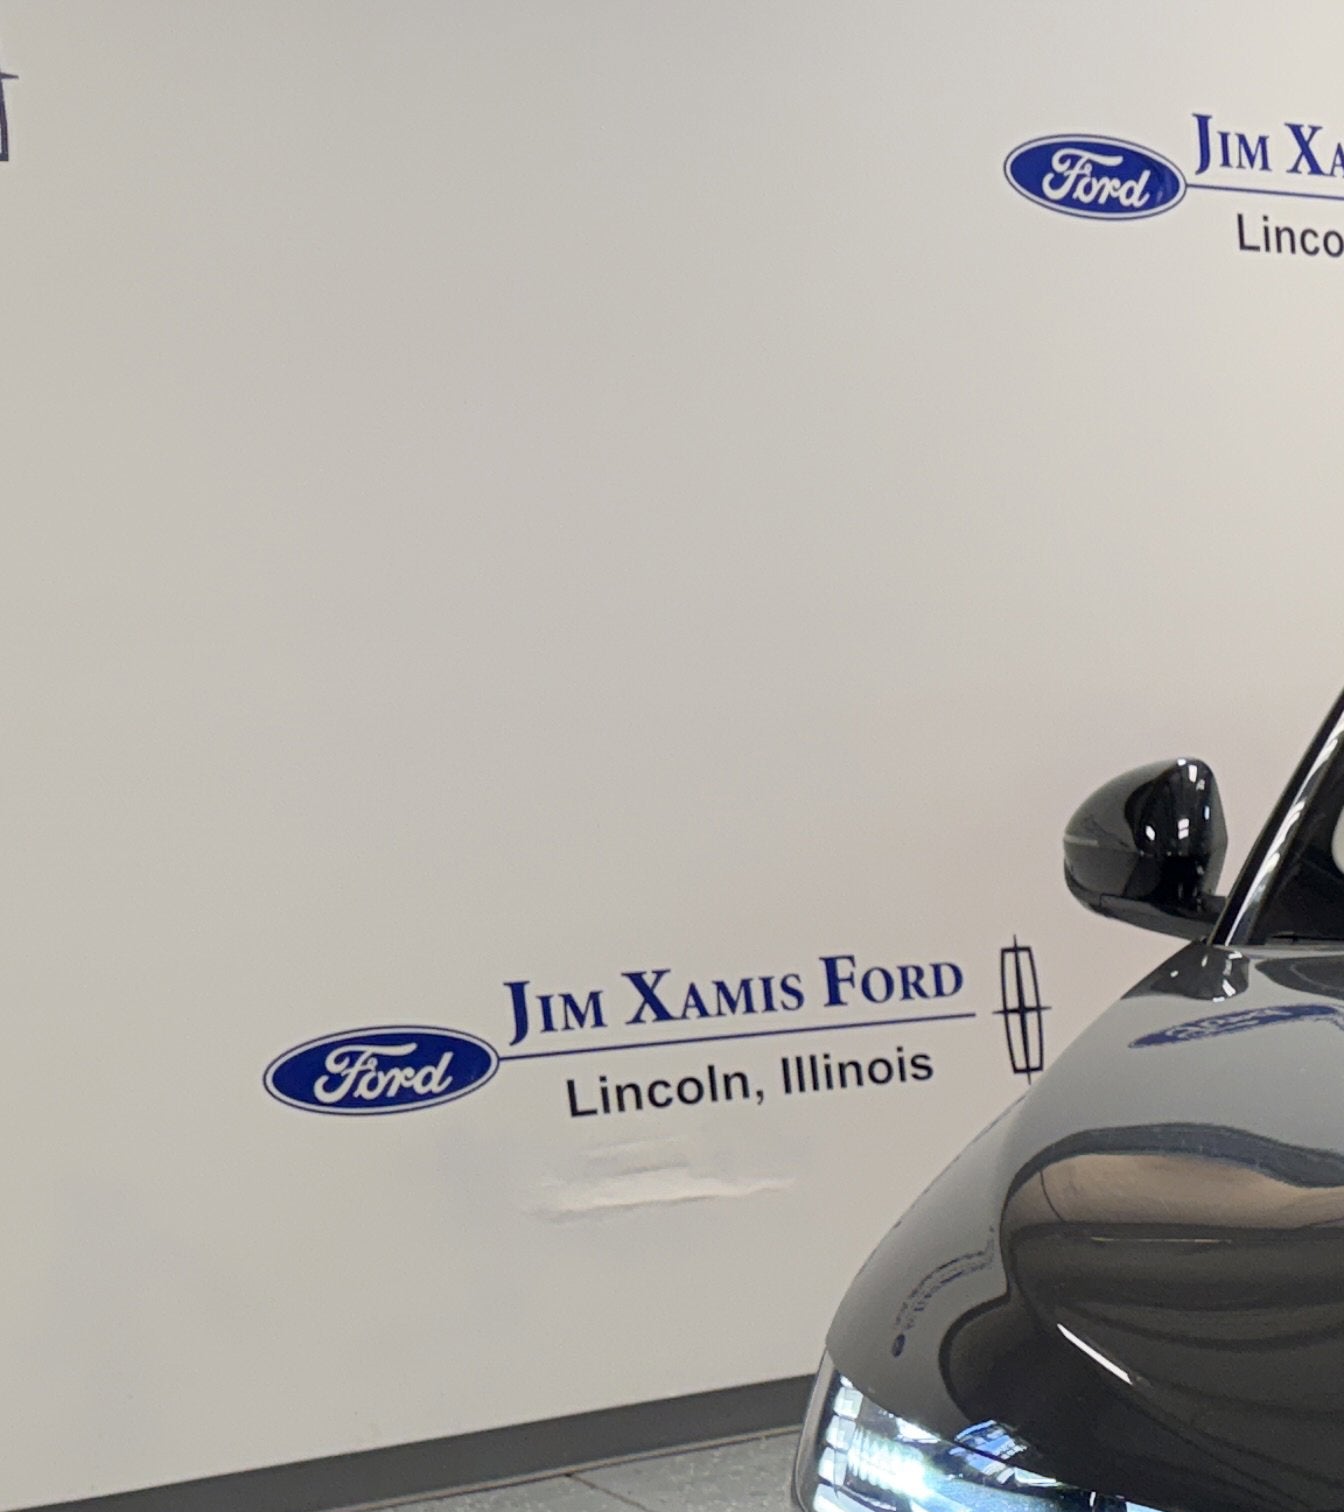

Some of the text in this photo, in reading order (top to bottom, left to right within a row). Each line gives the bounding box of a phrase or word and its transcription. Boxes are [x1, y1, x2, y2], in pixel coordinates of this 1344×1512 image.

[1192, 112, 1272, 176] JIM
[1042, 147, 1151, 210] Ford
[503, 953, 965, 1046] JIM XAMIS FORD
[313, 1041, 455, 1104] Ford
[566, 1045, 935, 1118] Lincoln, Illinois
